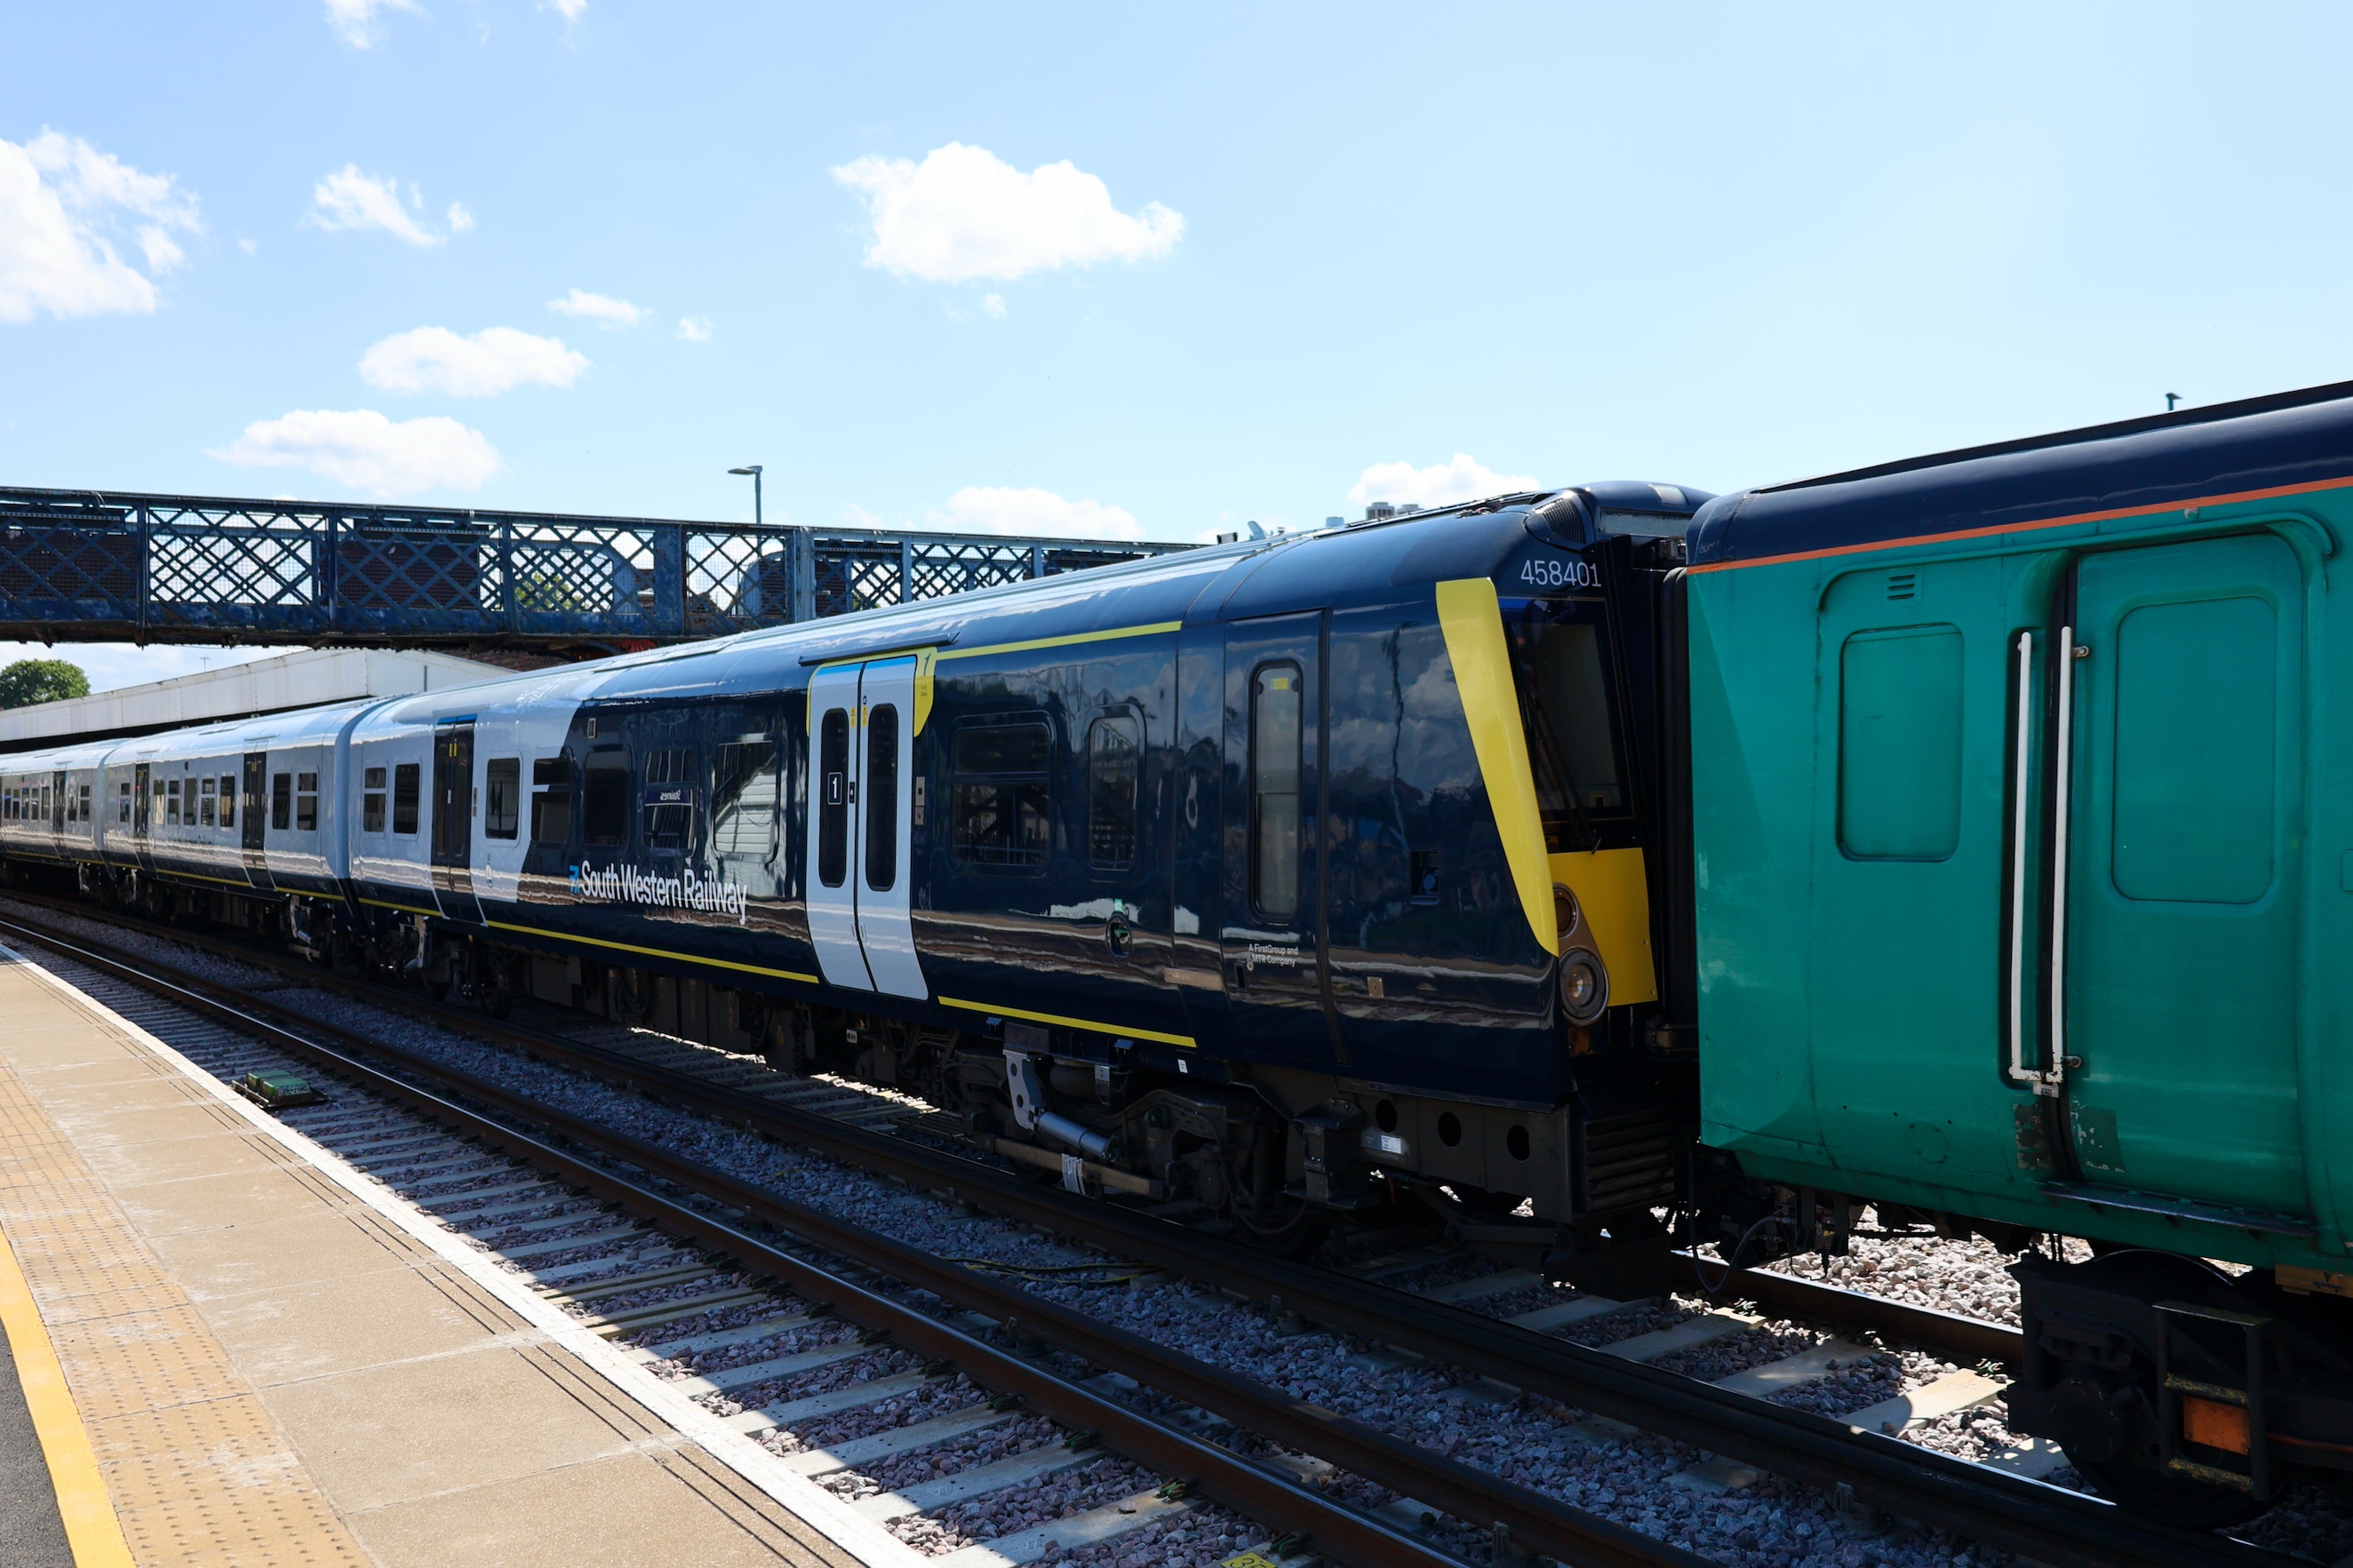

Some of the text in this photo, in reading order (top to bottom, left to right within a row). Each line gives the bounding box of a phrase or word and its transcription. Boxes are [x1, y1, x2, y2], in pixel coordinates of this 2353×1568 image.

[1520, 560, 1601, 587] 458401
[832, 776, 838, 800] 1
[581, 859, 747, 926] South Western Railway
[1248, 943, 1298, 955] A FirstGroup and
[1251, 953, 1296, 967] MTR Company
